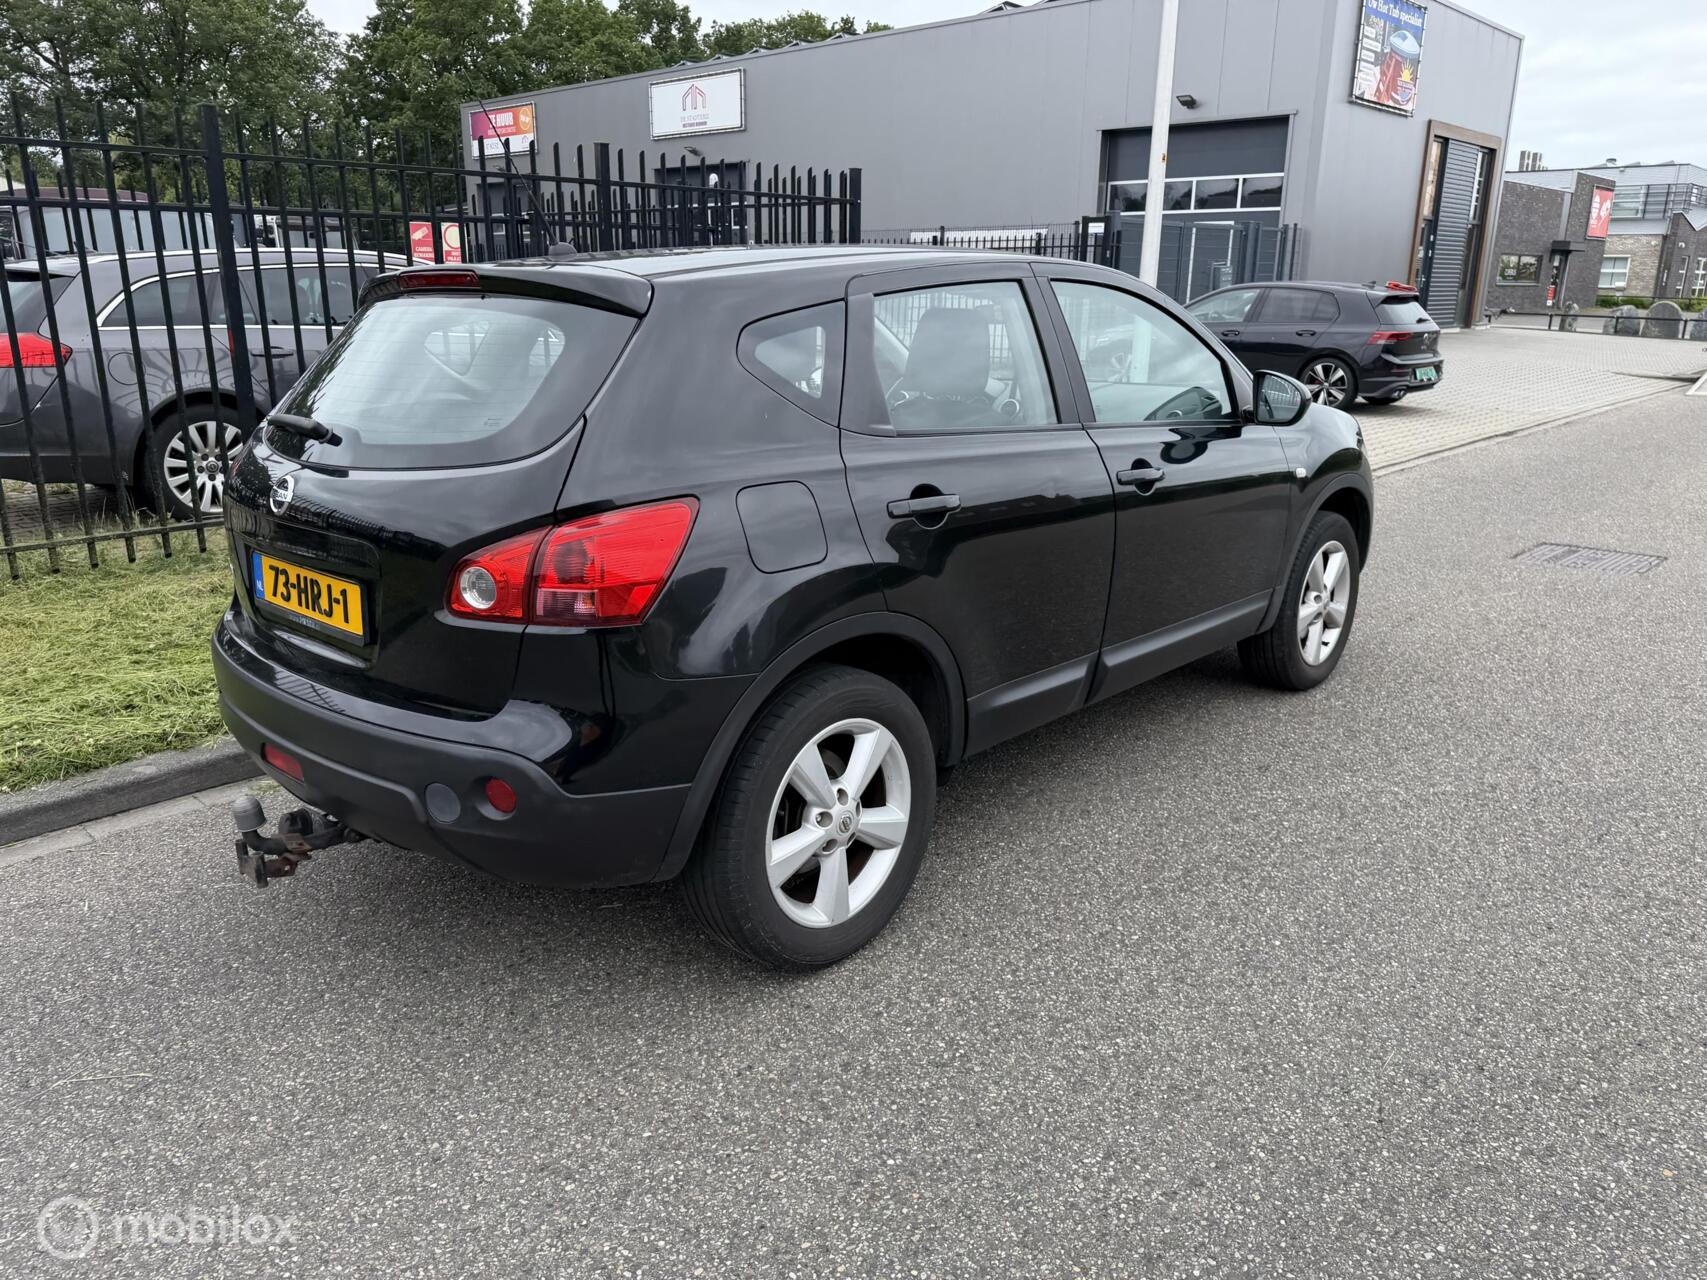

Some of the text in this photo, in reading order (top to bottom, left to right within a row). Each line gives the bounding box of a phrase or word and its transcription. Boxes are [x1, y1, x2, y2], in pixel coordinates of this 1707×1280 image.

[1377, 0, 1388, 14] Hot
[1389, 4, 1400, 18] Tub
[496, 112, 514, 127] HUUR
[268, 564, 350, 624] 73-HRJ-1
